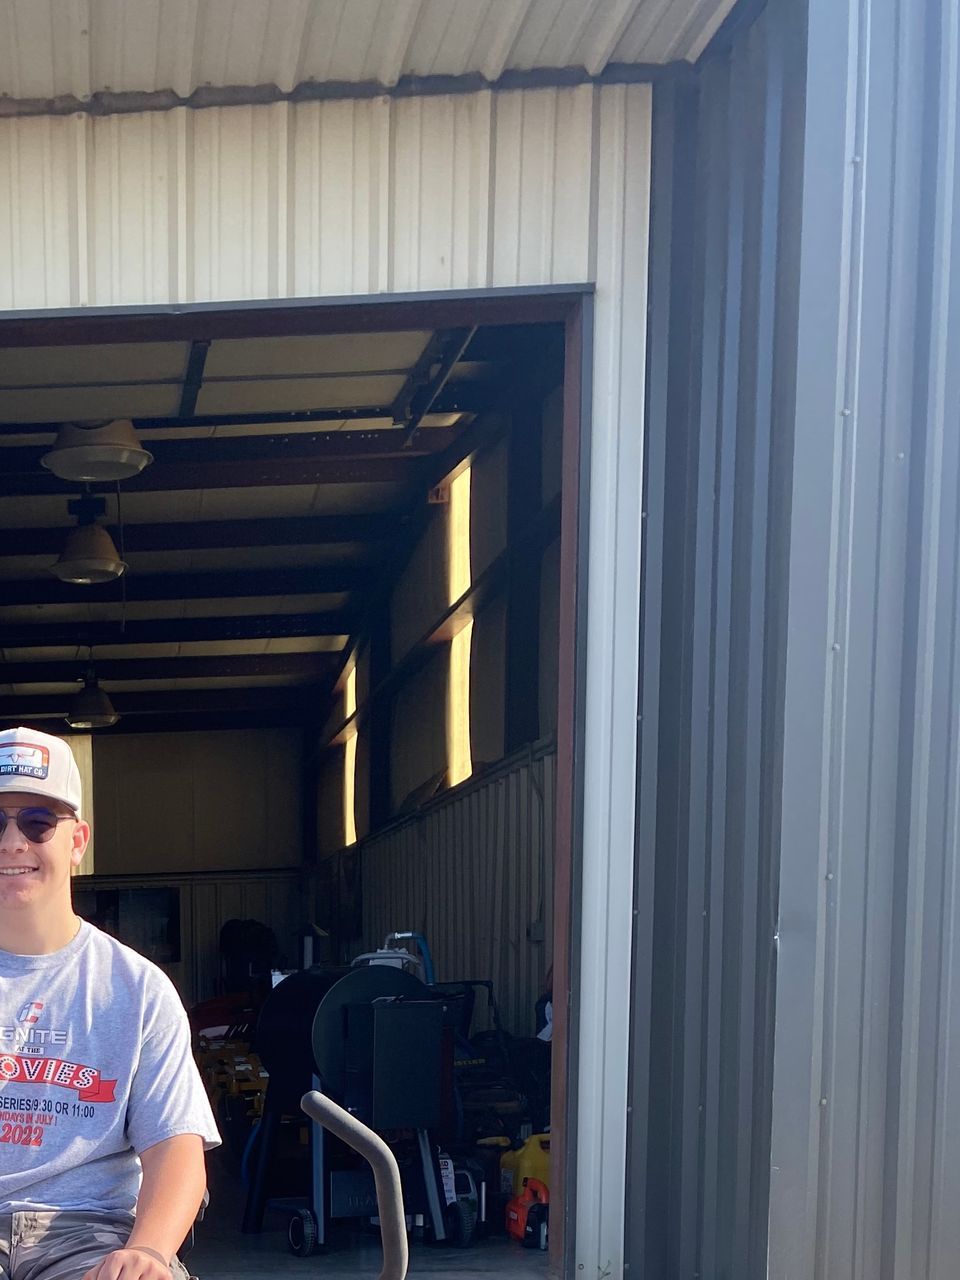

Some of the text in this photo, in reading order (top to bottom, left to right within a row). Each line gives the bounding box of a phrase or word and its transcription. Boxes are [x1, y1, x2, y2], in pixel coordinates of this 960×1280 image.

[55, 1101, 69, 1115] OR
[72, 1104, 95, 1118] 11:00
[35, 1113, 53, 1125] JULY
[0, 1122, 44, 1147] 2022
